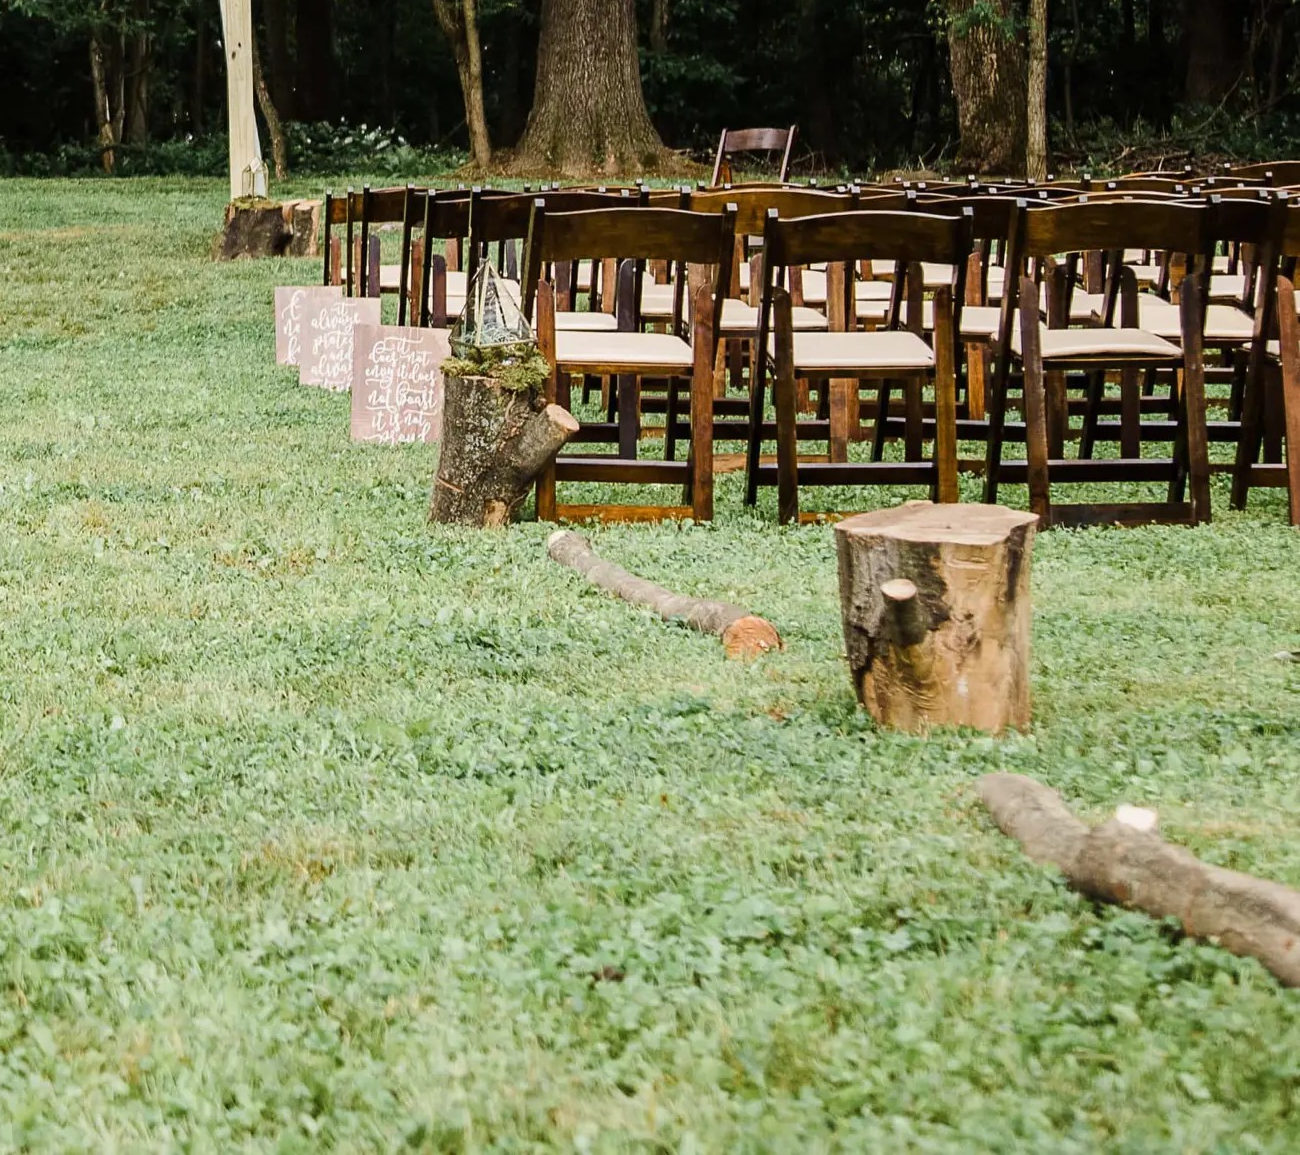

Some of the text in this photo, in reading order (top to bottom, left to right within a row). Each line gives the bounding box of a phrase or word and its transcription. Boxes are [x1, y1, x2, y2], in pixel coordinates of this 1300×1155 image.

[312, 331, 354, 354] protec
[368, 341, 432, 368] does not
[365, 363, 437, 389] envy it does
[366, 381, 437, 414] not boast
[372, 409, 437, 432] it is not
